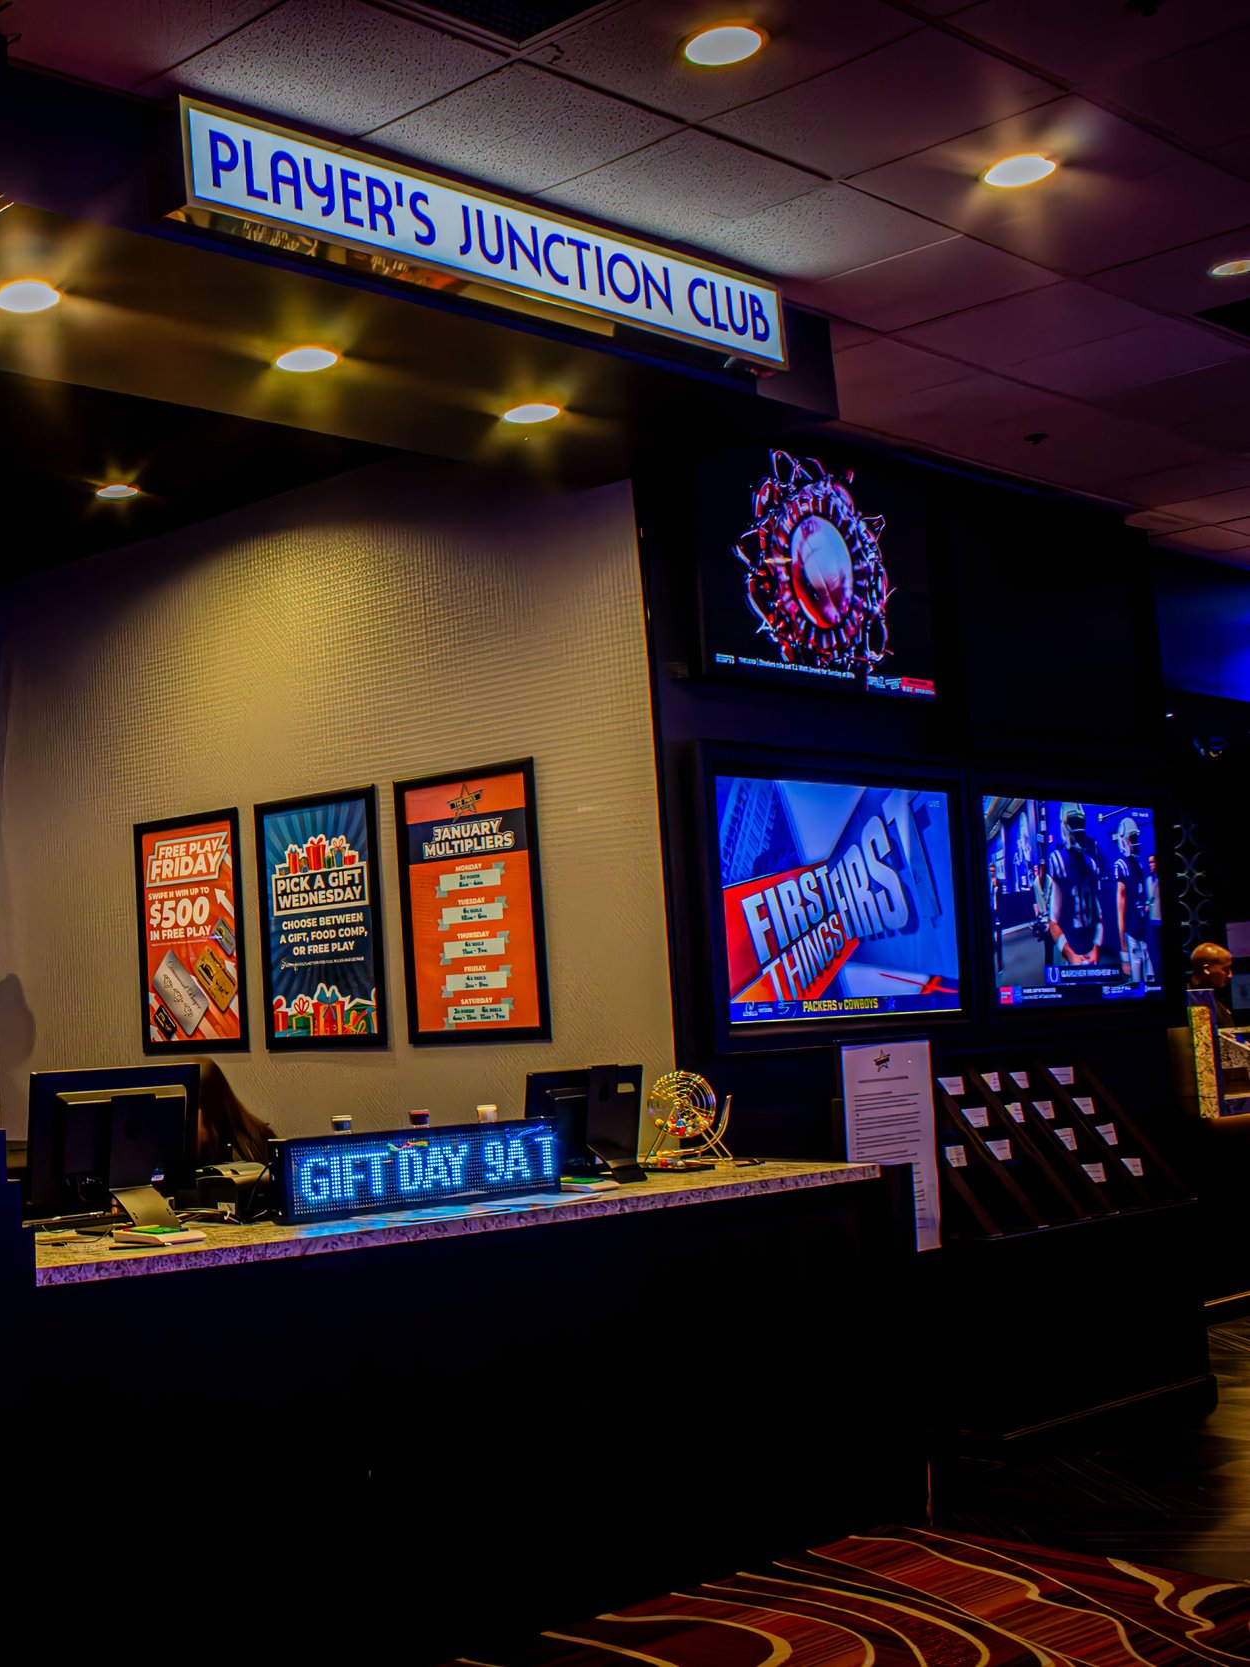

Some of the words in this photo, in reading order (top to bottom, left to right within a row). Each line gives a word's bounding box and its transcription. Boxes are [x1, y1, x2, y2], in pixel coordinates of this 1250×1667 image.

[208, 128, 436, 246] PLAYER'S
[458, 204, 674, 317] JUNCTION
[687, 276, 770, 343] CLUB
[433, 819, 500, 842] JANUARY
[158, 841, 187, 859] FREE
[188, 837, 219, 855] PLAY
[424, 832, 514, 858] MULTIPLIERS
[150, 851, 222, 882] FRIDAY
[455, 863, 483, 872] MONDAY
[828, 786, 943, 940] FIRST
[276, 876, 312, 895] PICK
[313, 873, 324, 890] A
[328, 868, 362, 888] GIFT
[148, 892, 168, 900] SWIPE
[169, 890, 174, 898] N
[175, 889, 189, 897] WIN
[190, 887, 199, 895] UP
[200, 886, 209, 894] TO
[278, 885, 363, 910] WEDNESDAY
[457, 897, 486, 905] TUESDAY
[149, 896, 210, 929] $500
[282, 917, 318, 931] CHOOSE
[319, 912, 364, 927] BETWEEN
[741, 865, 834, 965] FIRST
[150, 930, 160, 941] IN
[162, 927, 186, 940] FREE
[186, 925, 211, 938] PLAY
[280, 934, 287, 944] A
[287, 931, 310, 944] GIFT,
[311, 929, 337, 941] FOOD
[338, 926, 369, 939] COMP,
[457, 930, 490, 940] THURSDAY
[293, 945, 308, 956] OR
[308, 943, 330, 954] FREE
[331, 940, 356, 952] PLAY
[761, 913, 844, 1000] THINGS
[463, 965, 487, 973] FRIDAY
[460, 996, 493, 1005] SATURDAY
[802, 999, 837, 1012] PACKERS
[843, 998, 878, 1011] COWBOYS
[300, 1150, 390, 1201] GIFT
[399, 1143, 470, 1191] DAY
